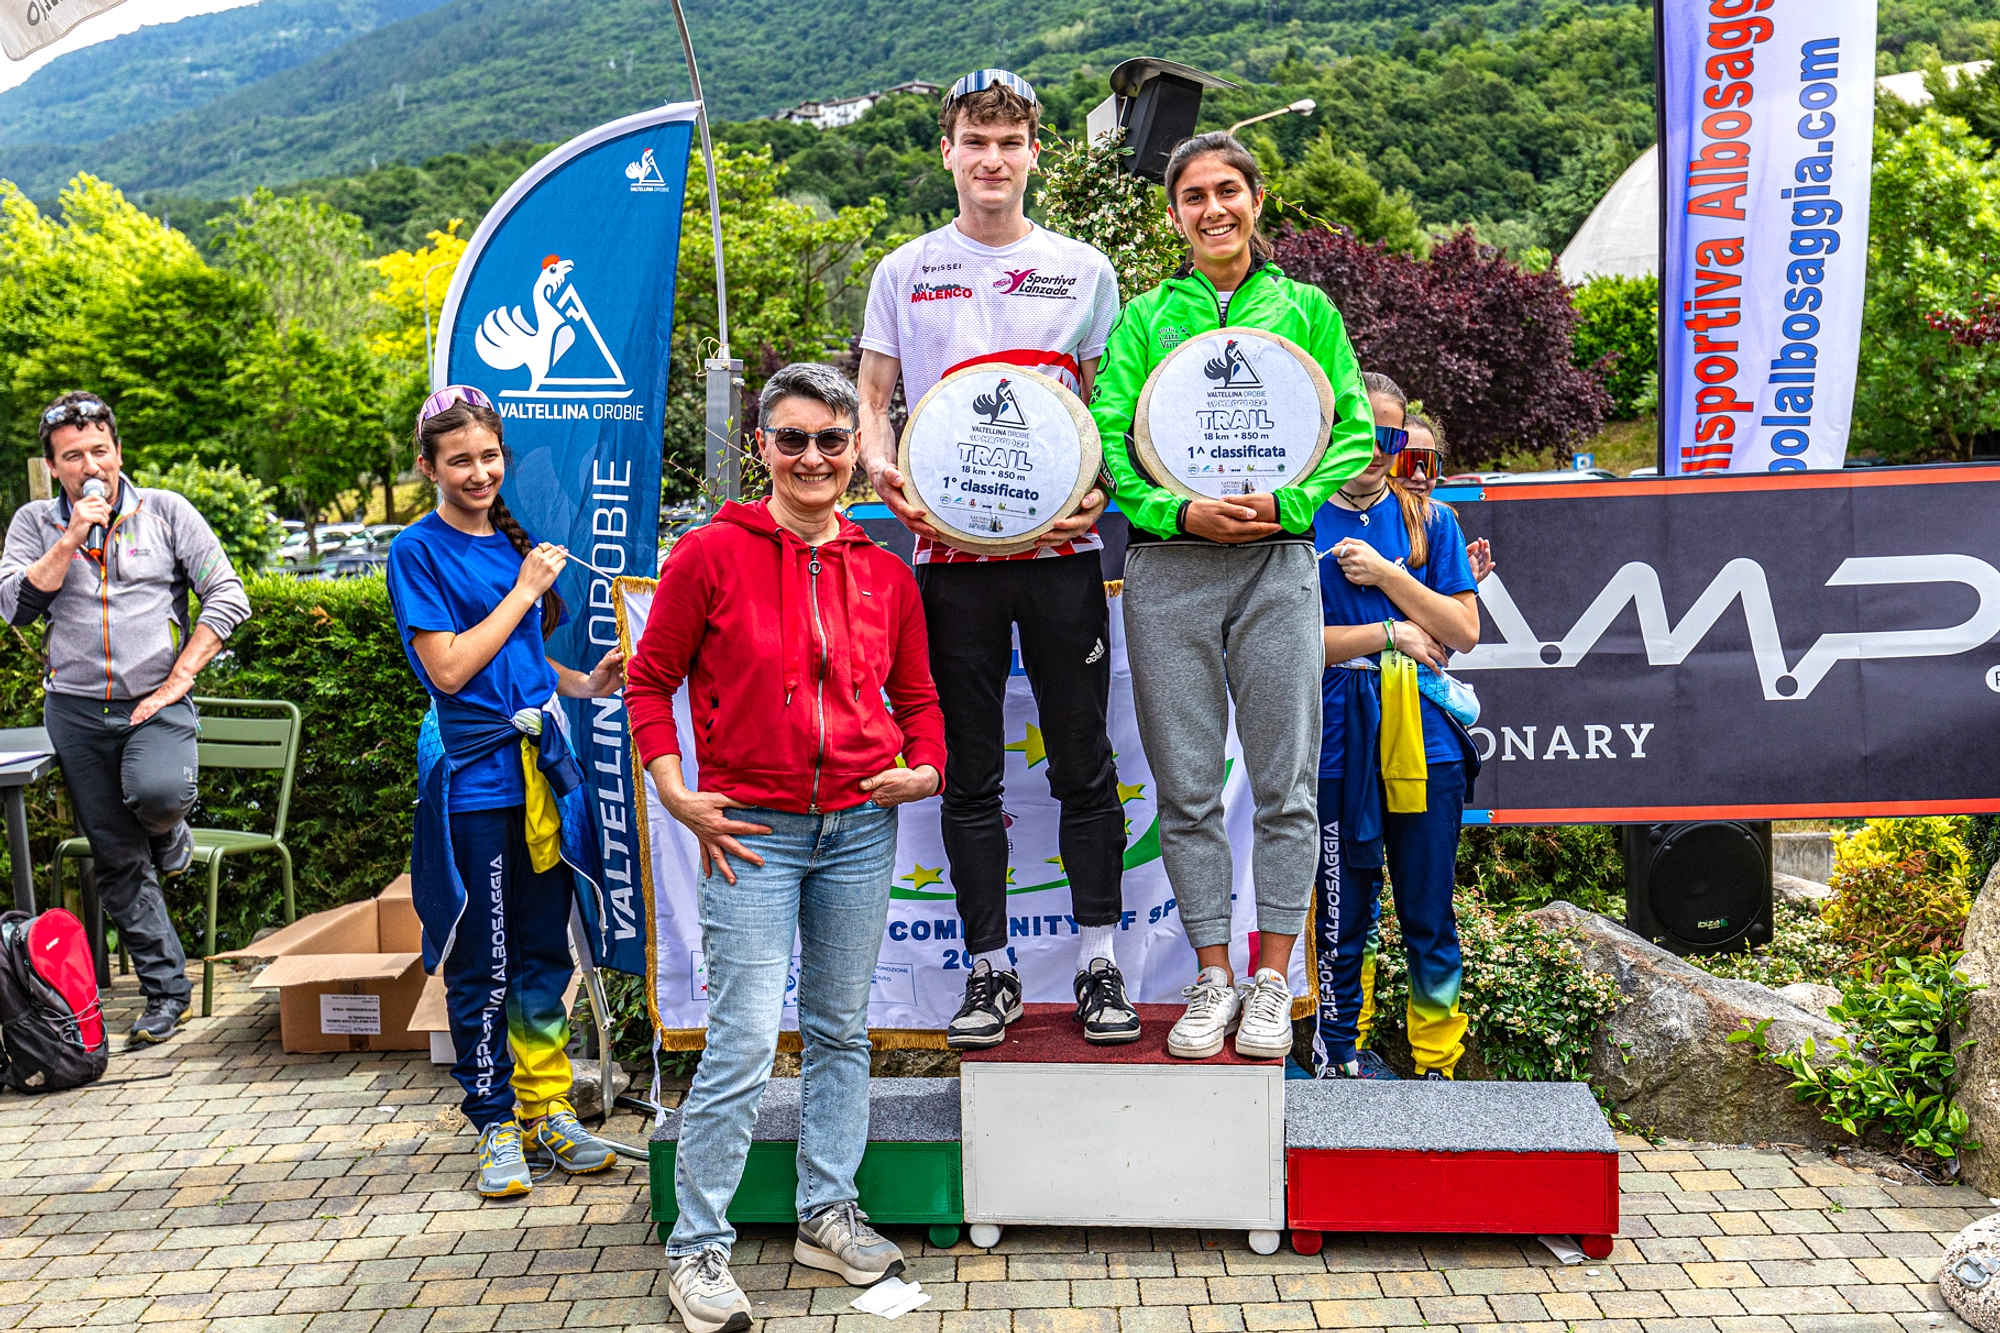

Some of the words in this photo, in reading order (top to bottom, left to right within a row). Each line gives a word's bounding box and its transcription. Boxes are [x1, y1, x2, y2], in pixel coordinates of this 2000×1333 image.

[1018, 282, 1069, 295] Lanzada
[1026, 272, 1077, 286] Sportiva
[911, 287, 973, 303] MALENCO
[1681, 237, 1754, 475] lisportiva
[498, 402, 589, 420] VALTELLINA
[592, 403, 644, 421] OROBIE
[1195, 409, 1275, 430] TRAIL
[971, 425, 1007, 436] VALTELLINA
[1204, 432, 1213, 440] 18
[1215, 432, 1229, 440] km
[1241, 432, 1259, 440] 850
[957, 442, 1033, 471] TRAIL
[1210, 444, 1286, 459] classificata
[961, 465, 971, 473] 18
[973, 466, 986, 476] km
[998, 470, 1016, 480] 850
[960, 479, 1040, 501] classificato
[589, 460, 632, 646] OROBIE
[590, 669, 636, 940] VALTELLIN
[1323, 820, 1340, 944] ALBOSAGGIA
[490, 854, 507, 982] ALBOSAGGIA
[889, 915, 1080, 941] COMNITY
